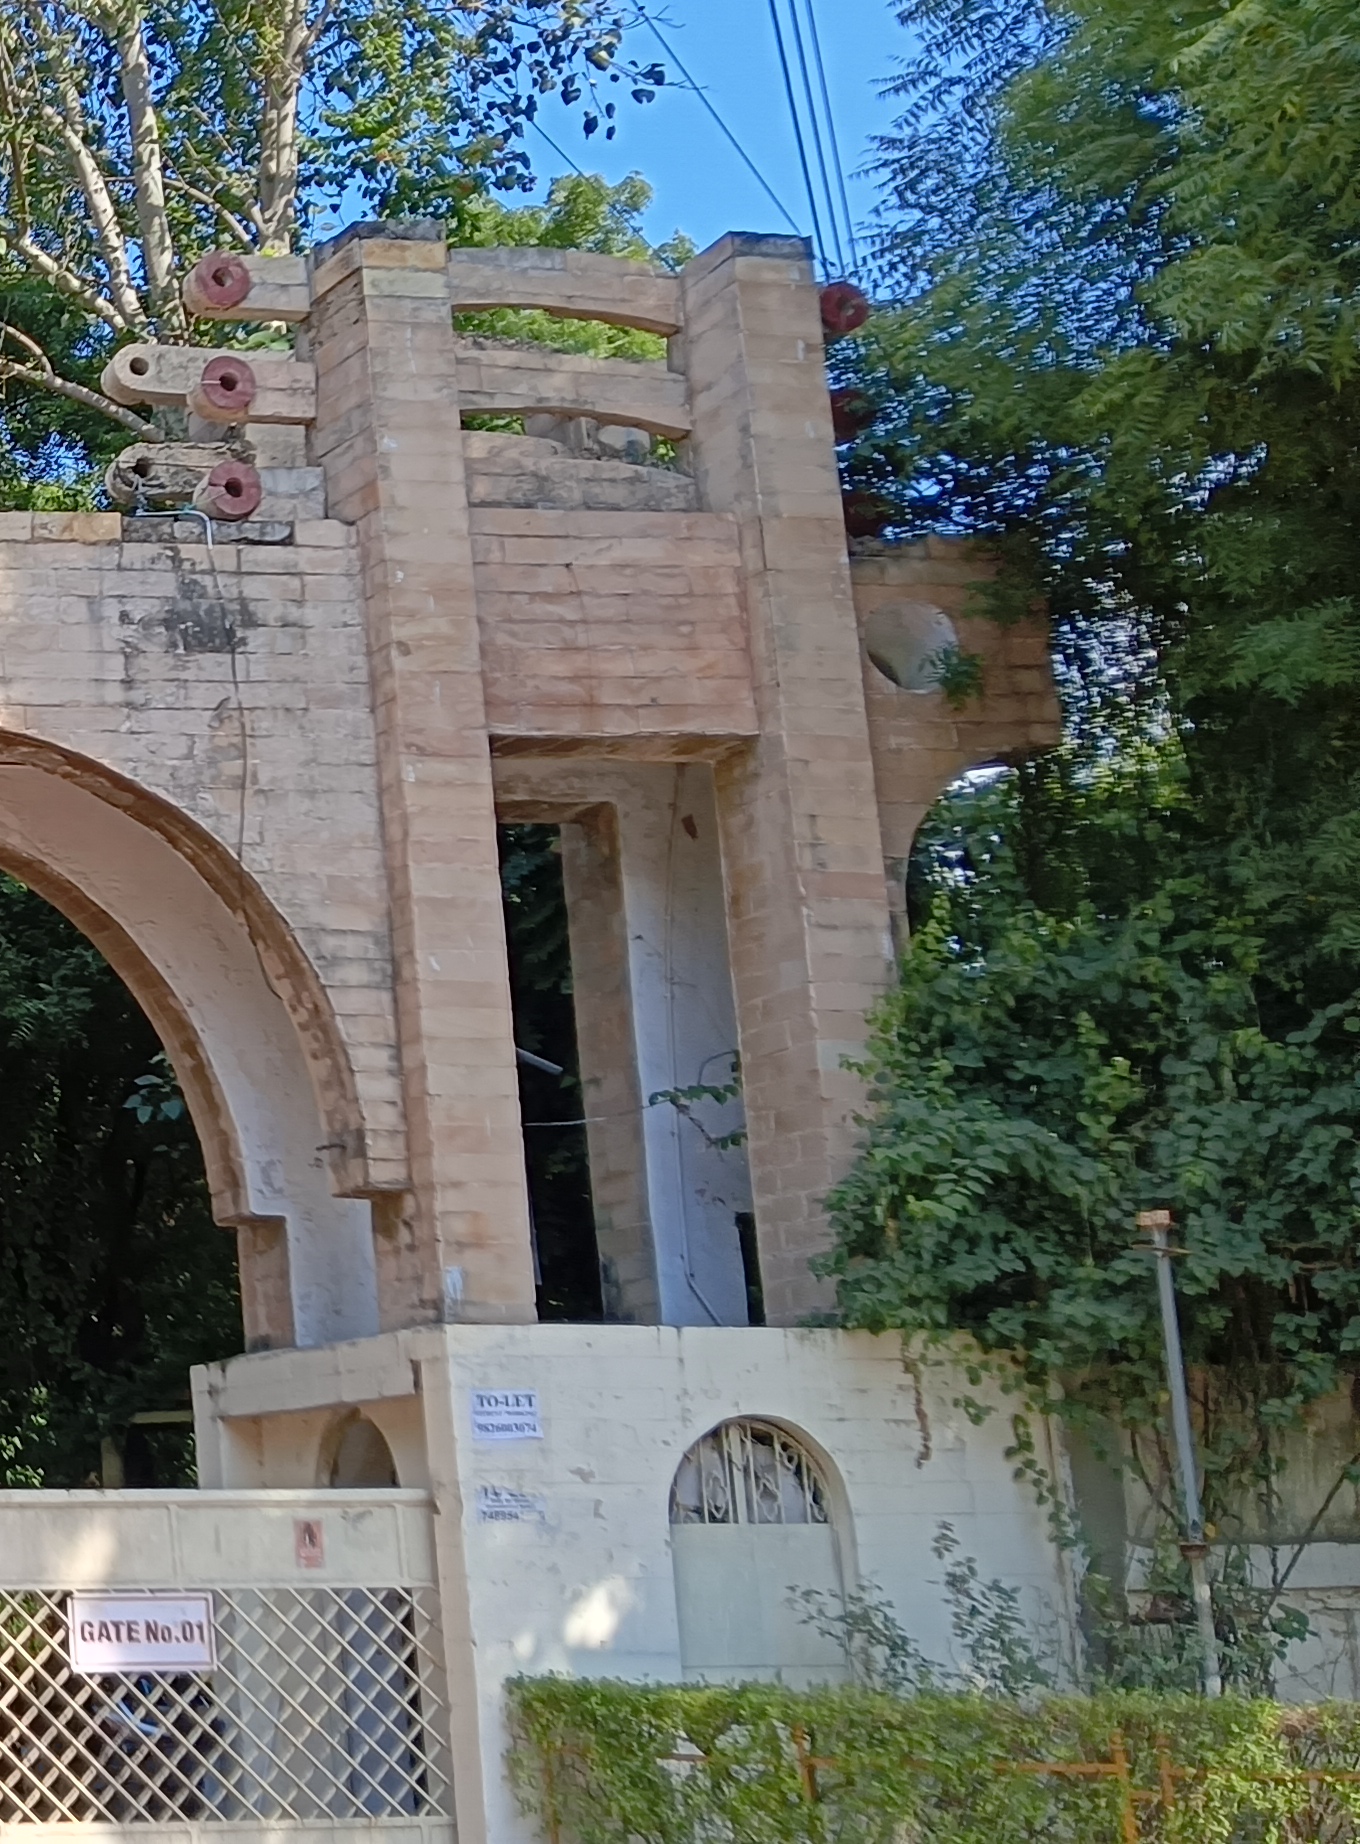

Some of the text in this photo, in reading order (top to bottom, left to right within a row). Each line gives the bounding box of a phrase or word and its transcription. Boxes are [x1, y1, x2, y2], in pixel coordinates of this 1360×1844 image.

[476, 1394, 536, 1408] TO-LET
[80, 1618, 206, 1644] GATE No.01
